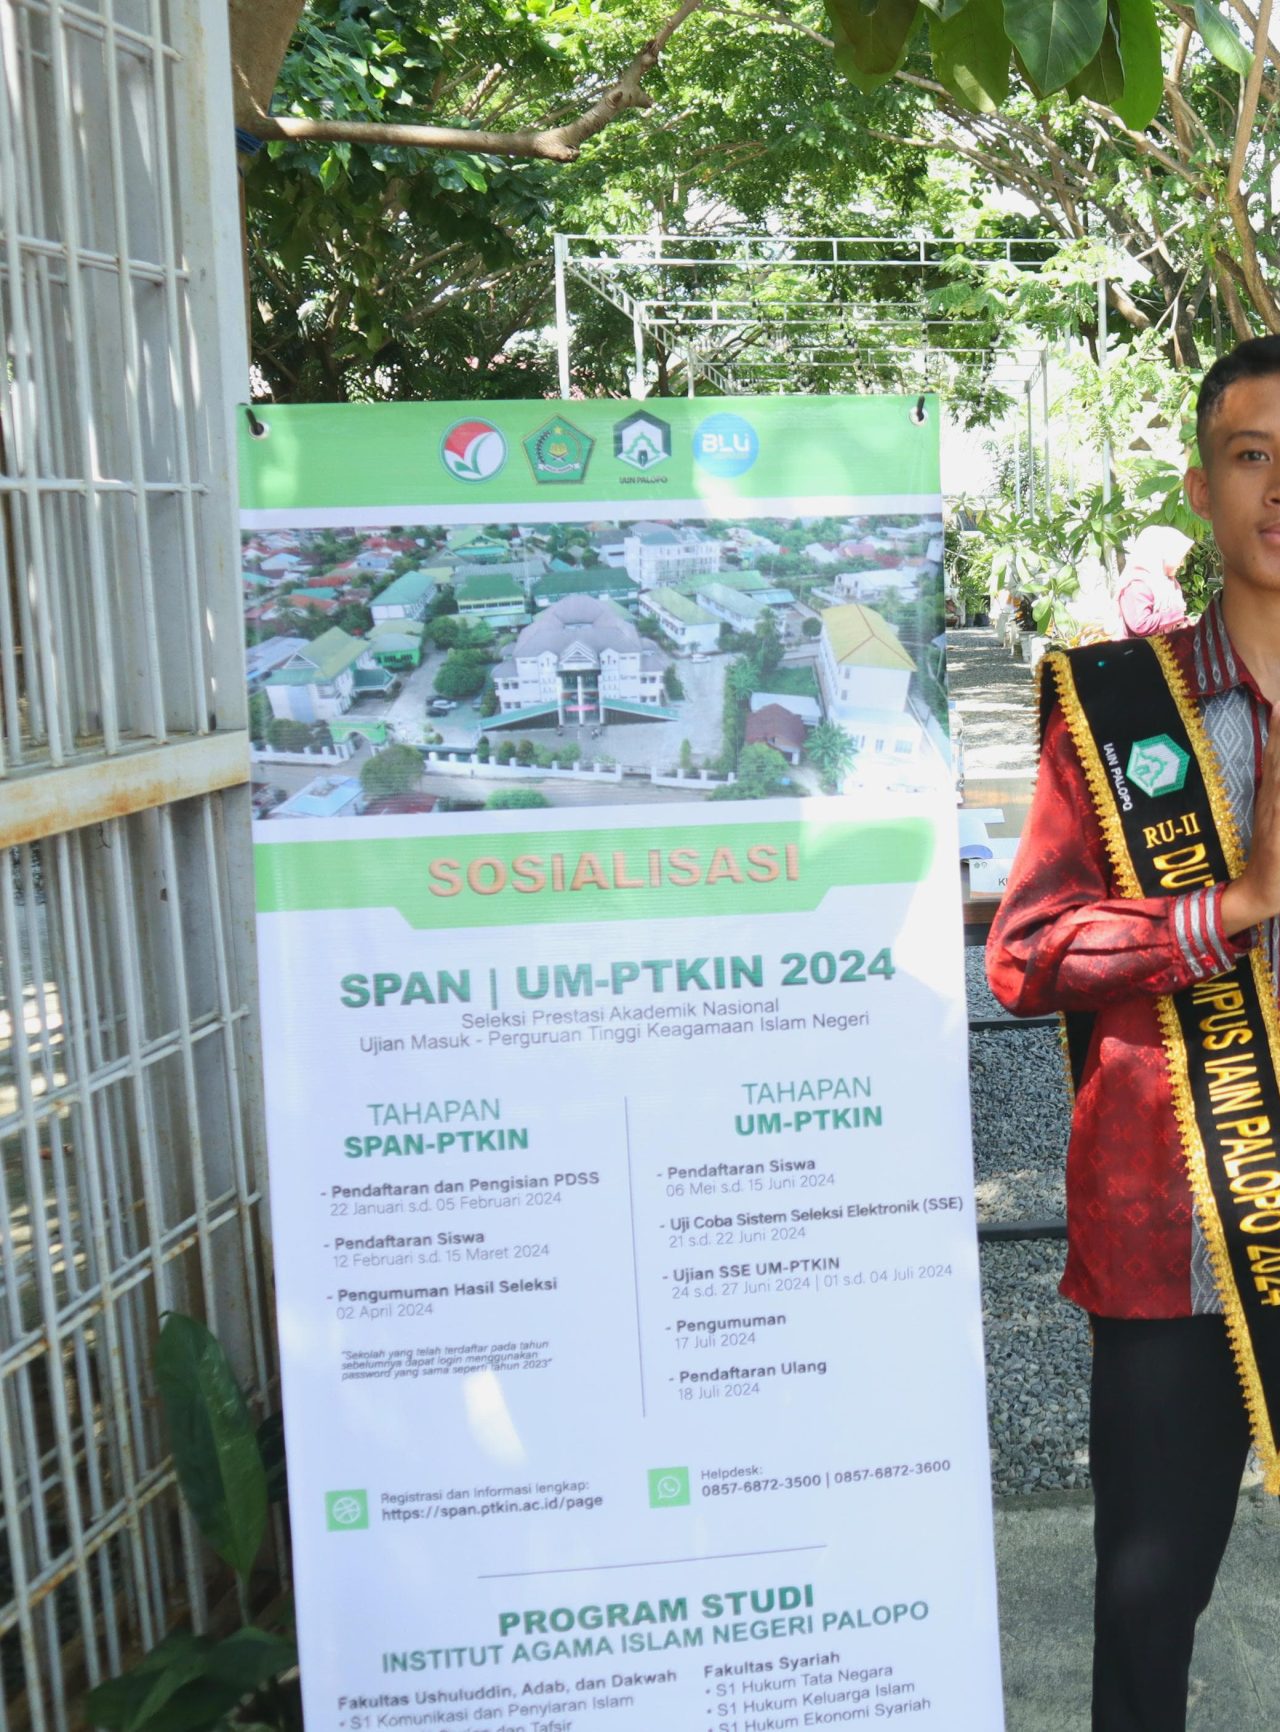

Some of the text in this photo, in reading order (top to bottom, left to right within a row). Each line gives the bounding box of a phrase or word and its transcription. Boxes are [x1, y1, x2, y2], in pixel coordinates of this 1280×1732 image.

[1103, 742, 1133, 812] IAIN PALOPO
[1142, 812, 1201, 849] RU-II
[427, 843, 800, 899] SOSIALISASI
[340, 947, 896, 1009] SPAN UM-PTKIN 2024
[461, 997, 780, 1030] Seleksi Prestasi Akademik Nasional
[359, 1013, 870, 1055] Ujian Masuk Perguruan Tinggi Keagamaan Islam Negeri
[741, 1076, 872, 1105] TAHAPAN
[1204, 1051, 1264, 1116] IAIN
[366, 1098, 501, 1126] TAHAPAN
[735, 1105, 883, 1137] UM-PTKIN
[344, 1127, 529, 1159] SPAN-PTKIN
[667, 1159, 816, 1179] Pendaftaran Siswa
[331, 1171, 600, 1199] Pendaftaran dan Pengisian PDSS
[665, 1172, 836, 1198] 06 Mei 15 Juni 2024
[352, 1191, 562, 1216] Januari Februari 2024
[670, 1196, 964, 1234] Uji Coba Sistem Seleksi Elektronik (SSE)
[334, 1231, 485, 1251] Pendaftaran Siswa
[668, 1225, 807, 1249] 21 22 Juni 2024
[352, 1243, 551, 1268] Februari Maret 2024
[671, 1263, 953, 1300] 24 27 Juni 2024 01 04 Juli 2024
[673, 1257, 840, 1285] Ujian SSE UM-PTKIN
[337, 1277, 557, 1305] Pengumuman Hasil Seleksi
[358, 1302, 434, 1321] April 2024
[676, 1314, 787, 1335] Pengumuman
[387, 1349, 413, 1360] yang
[416, 1346, 441, 1356] telah
[444, 1344, 488, 1354] terdaftar
[490, 1342, 517, 1353] pada
[674, 1331, 756, 1350] 17 Juli 2024
[404, 1356, 434, 1368] dapat
[437, 1354, 463, 1366] login
[465, 1350, 539, 1364] menggunakan
[679, 1361, 827, 1384] Pendaftaran Ulang
[341, 1367, 391, 1381] password
[393, 1367, 419, 1380] yang
[422, 1366, 450, 1376] sama
[678, 1381, 761, 1401] 18 Juli 2024
[700, 1464, 763, 1481] Helpdesk:
[701, 1459, 951, 1497] 0857-6872-3500 0857-6872-3600
[380, 1480, 589, 1507] Registrasi dan informasi lengkap:
[382, 1496, 604, 1523] https://span.ptkin.ac.id/page
[499, 1583, 814, 1637] PROGRAM STUDI
[382, 1600, 929, 1673] INSTITUT AGAMA ISLAM NEGERI PALOPO
[703, 1651, 840, 1678] Fakultas Syariah
[337, 1669, 677, 1710] Fakultas Ushuluddin, Adab, dan Dakwah
[716, 1666, 893, 1697] S1 Hukum Tata Negara
[349, 1695, 634, 1731] S1 Komunikasi dan Penyiaran Islam
[717, 1682, 915, 1717] S1 Hukum Keluarga Islam
[533, 1719, 573, 1732] Tafsir
[744, 1698, 931, 1732] Hukum Ekonomi Syariah
